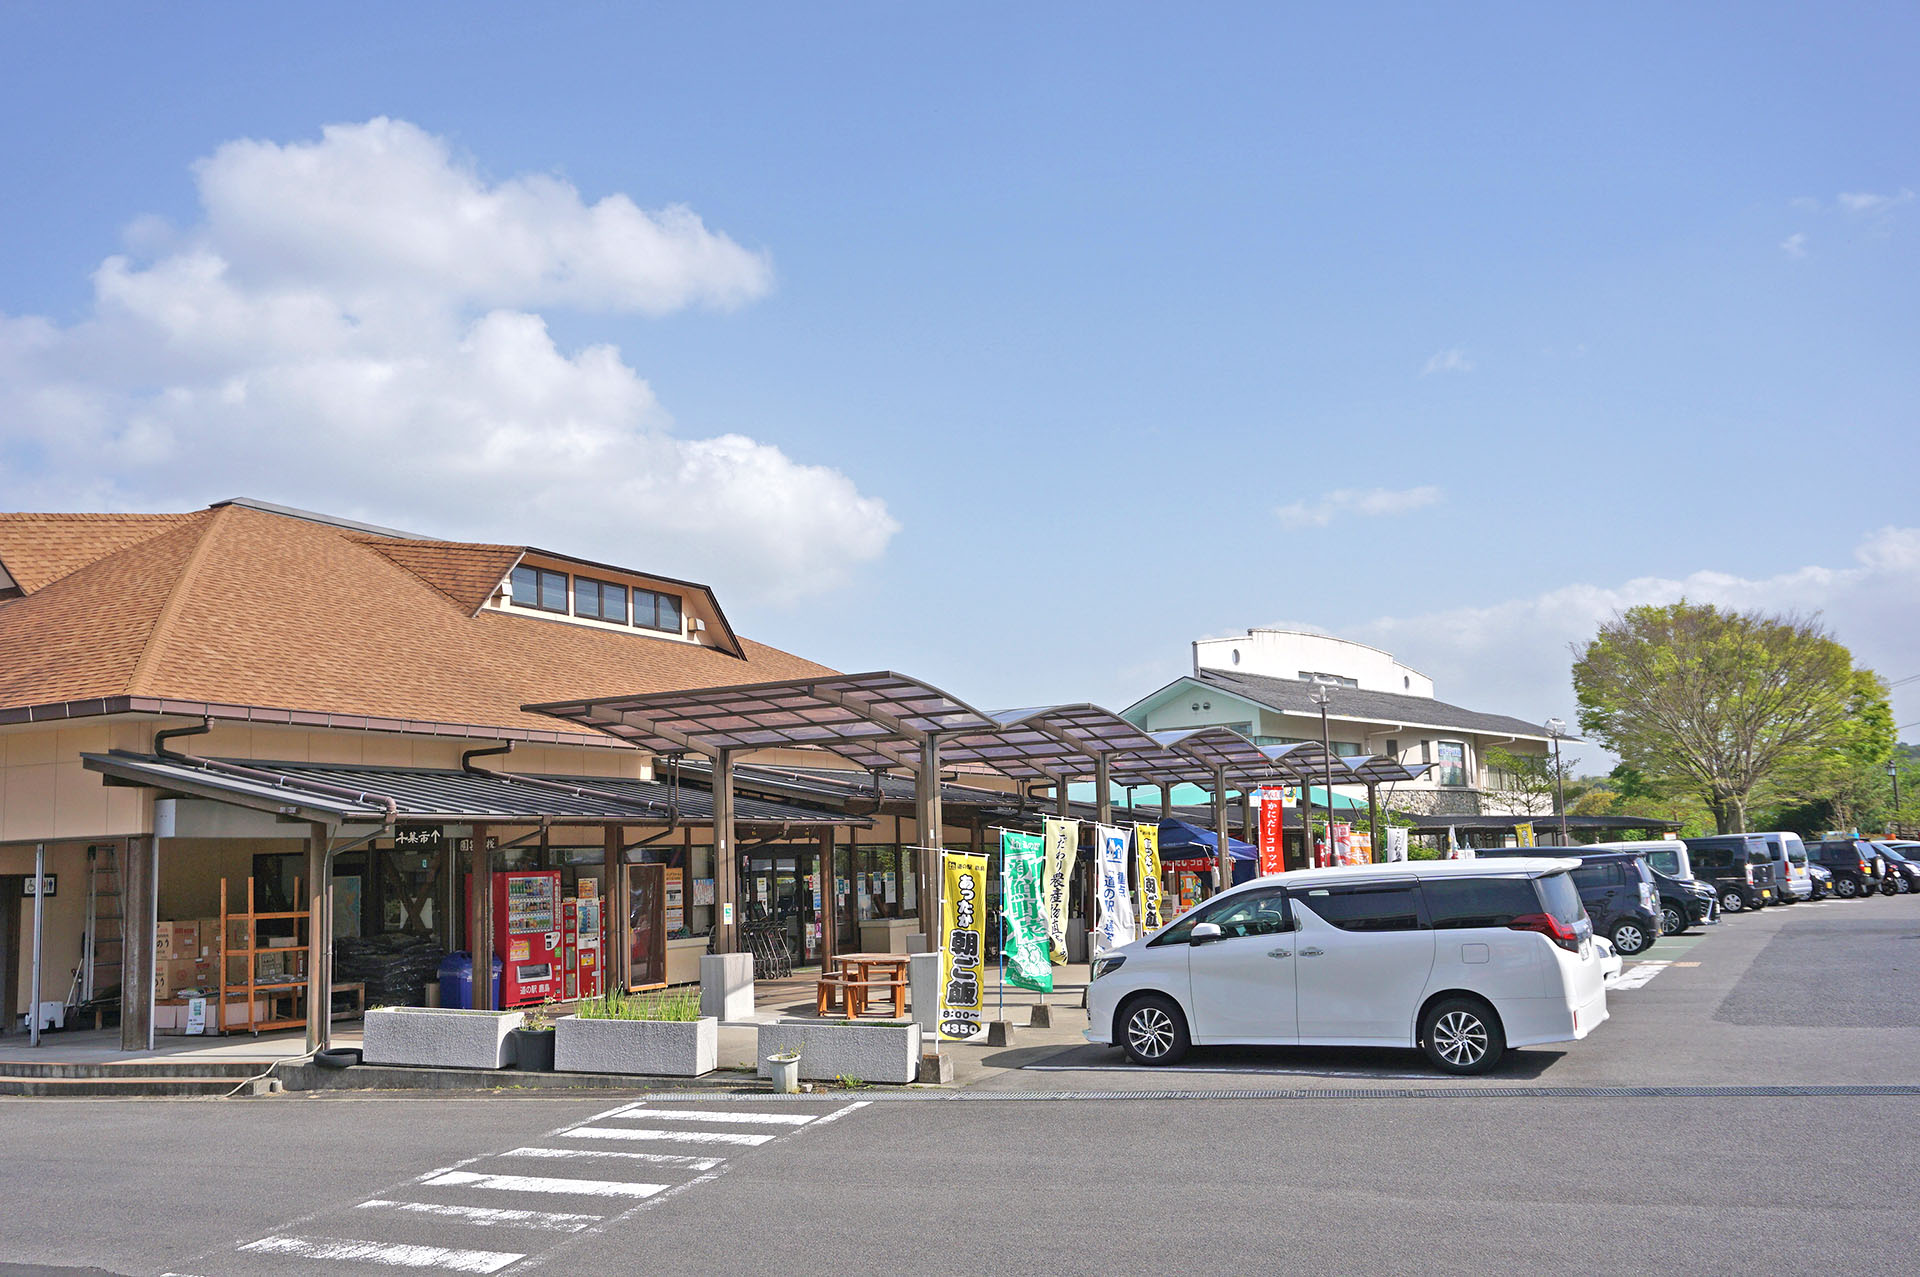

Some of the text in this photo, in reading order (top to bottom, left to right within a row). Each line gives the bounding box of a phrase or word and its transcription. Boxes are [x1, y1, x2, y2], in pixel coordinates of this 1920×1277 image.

[395, 831, 430, 844] 千菜市
[1266, 802, 1277, 870] かにだしコロッケ
[946, 874, 981, 1007] あったか朝ご飯
[519, 984, 538, 994] 道の駅
[940, 1022, 979, 1034] ¥350
